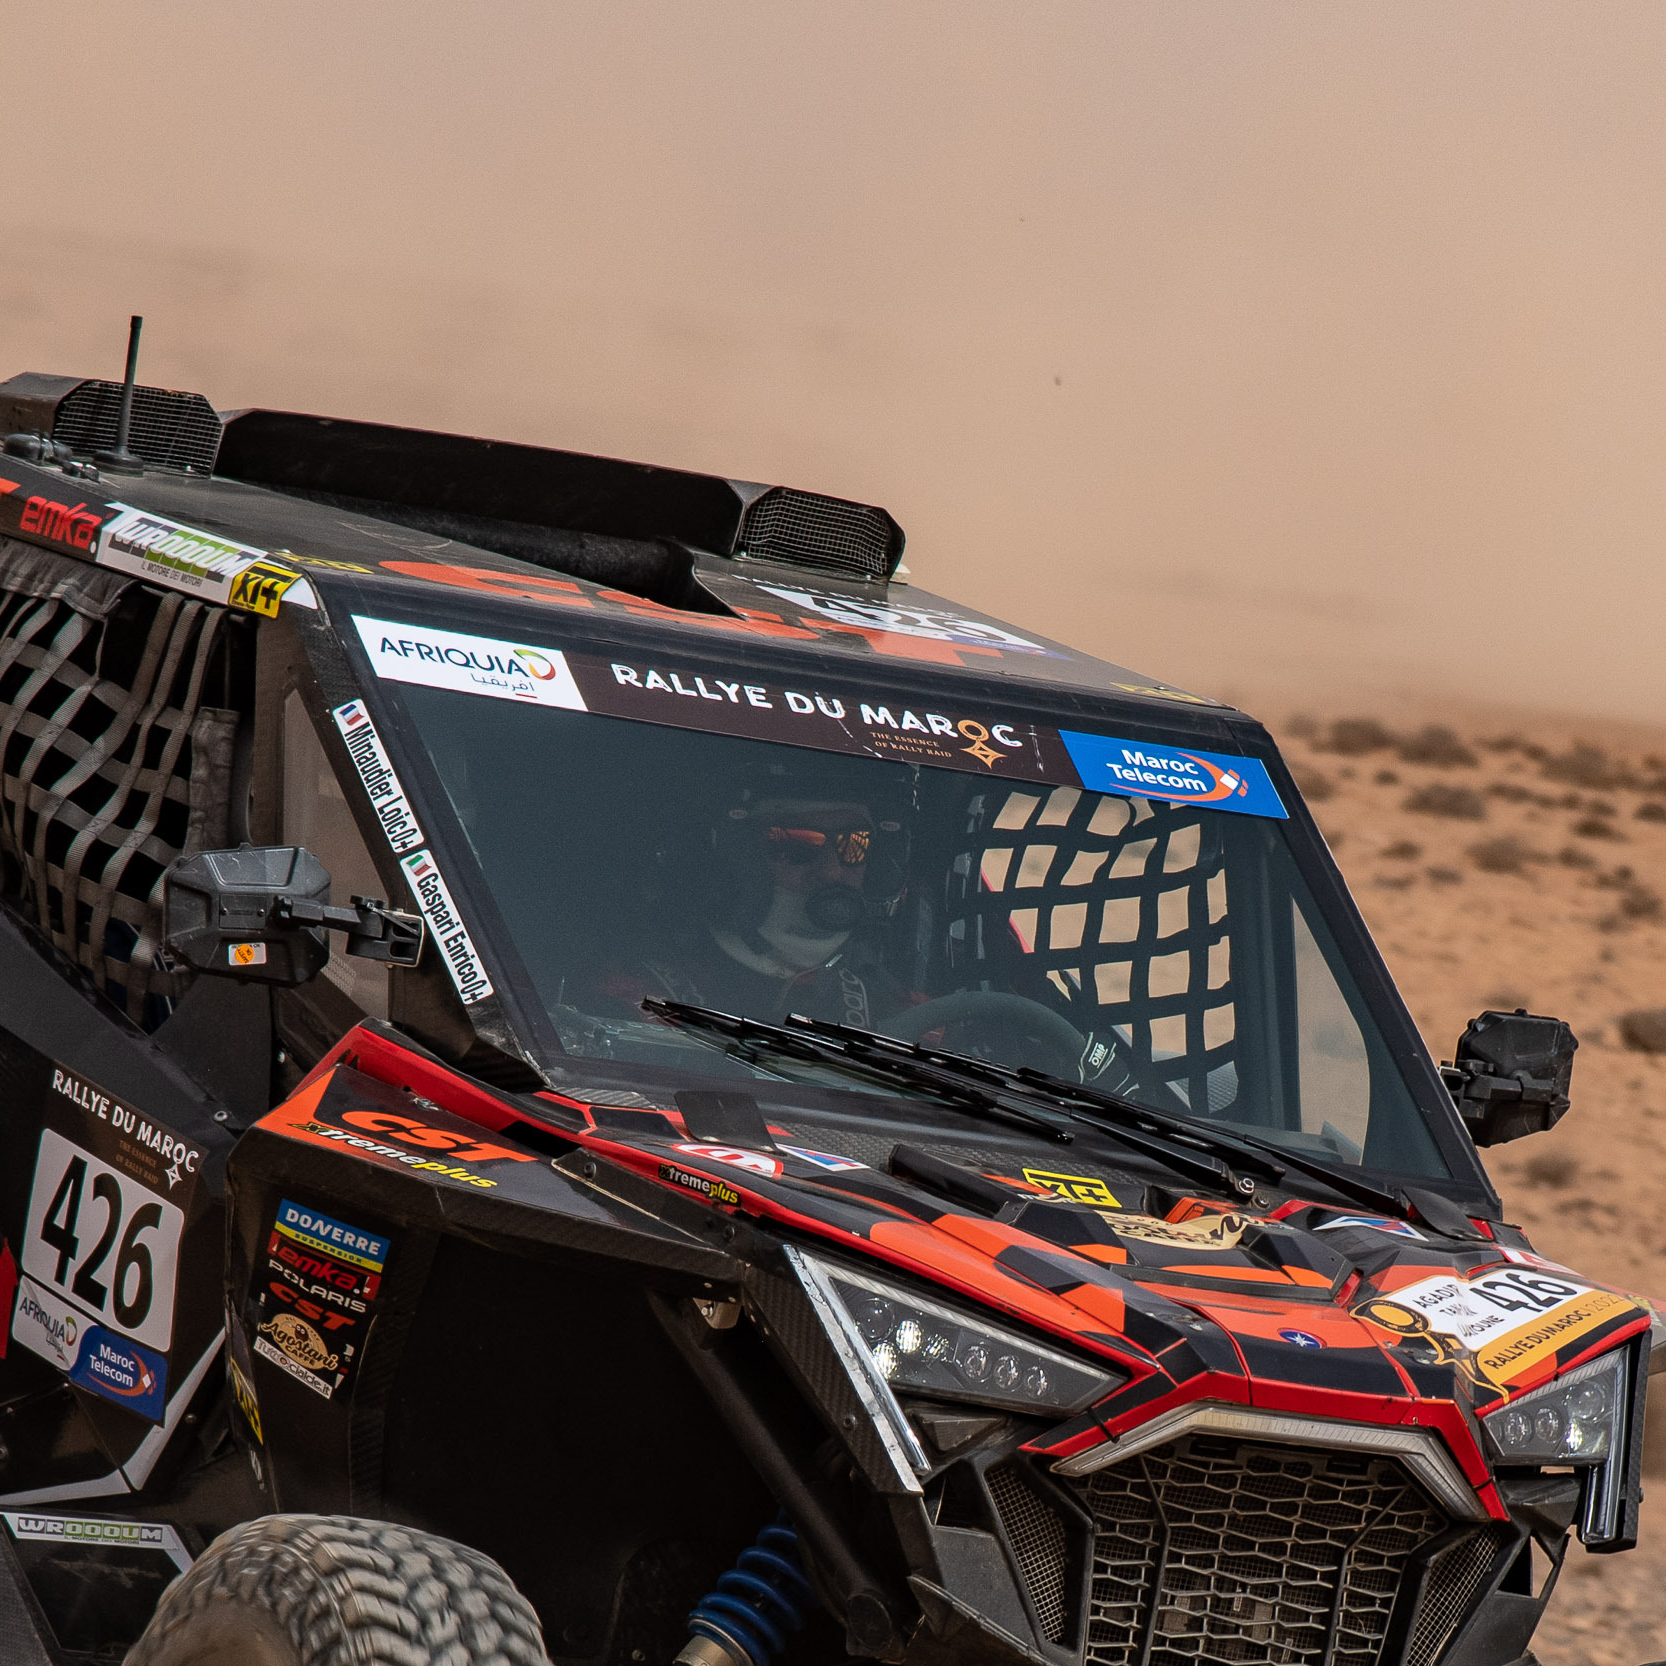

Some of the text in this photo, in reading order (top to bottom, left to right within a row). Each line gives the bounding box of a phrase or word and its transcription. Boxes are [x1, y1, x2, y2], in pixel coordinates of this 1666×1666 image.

[147, 562, 171, 578] MOTORE
[180, 572, 203, 587] MOTORI
[380, 636, 530, 678] AFRIQUIA
[611, 663, 1023, 747] RALLYE DU MAROC
[870, 731, 940, 748] THE ESSENCE
[875, 740, 952, 759] OF RALLY RAID
[344, 721, 395, 802] Minaudier
[377, 795, 411, 835] Loic
[1106, 763, 1208, 792] Telecom
[1121, 749, 1199, 775] Maroc
[417, 873, 461, 936] Gaspari
[443, 930, 476, 985] Enrico
[1091, 1043, 1107, 1066] OMP
[52, 1069, 199, 1173] RALLYE DU MAROC
[341, 1111, 539, 1162] CST
[40, 1154, 163, 1329] 426
[295, 1233, 363, 1265] SUSPENSION
[268, 1259, 367, 1314] POLARIS
[269, 1281, 356, 1331] CST
[1469, 1272, 1578, 1313] 426
[20, 1297, 66, 1343] AFRIQUIA
[1484, 1339, 1535, 1369] RALLYE
[1541, 1309, 1592, 1338] MAROC
[100, 1343, 135, 1371] Maroc
[260, 1321, 339, 1371] Agostani
[90, 1354, 134, 1388] Telecom
[19, 1518, 162, 1542] WROOOUM
